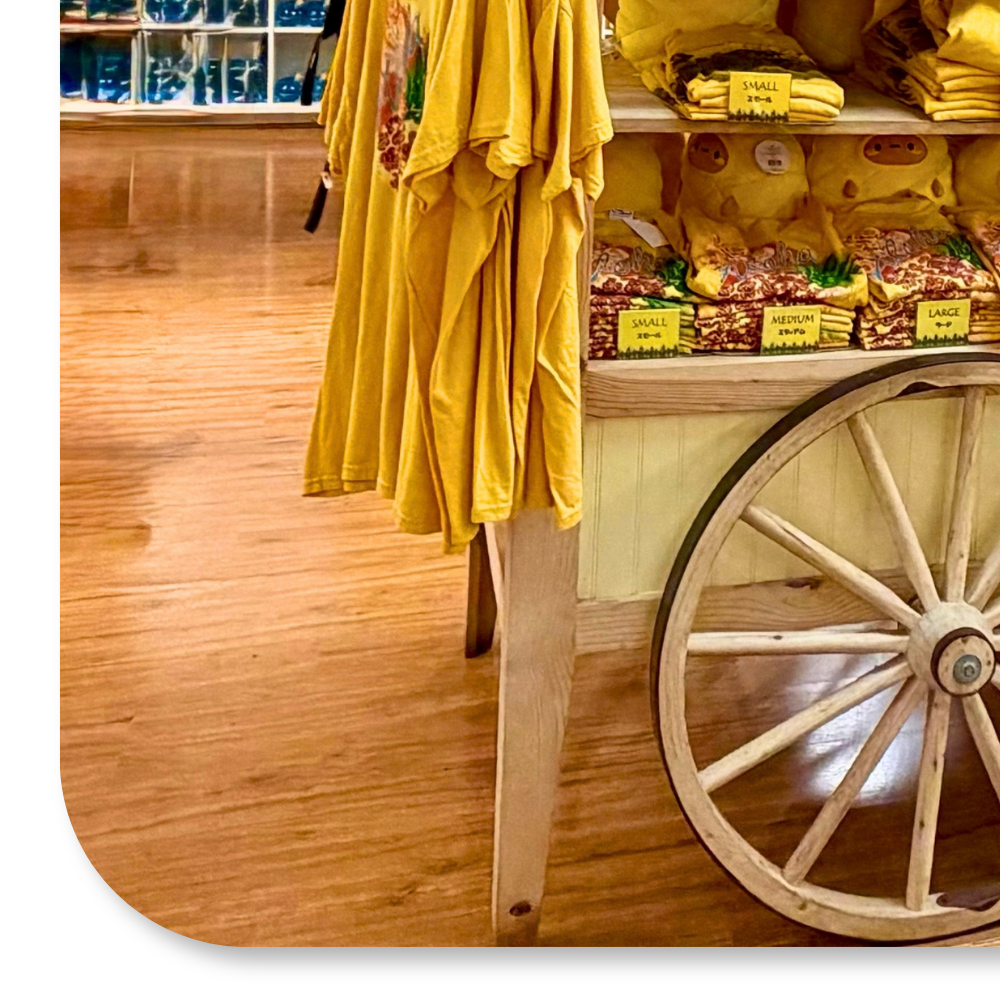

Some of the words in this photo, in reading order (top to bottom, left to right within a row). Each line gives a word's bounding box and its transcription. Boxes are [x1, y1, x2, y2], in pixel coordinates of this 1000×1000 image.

[742, 80, 779, 92] SMALL
[770, 313, 815, 325] MEDIUM
[928, 307, 961, 319] LARGE
[631, 317, 668, 329] SMALL
